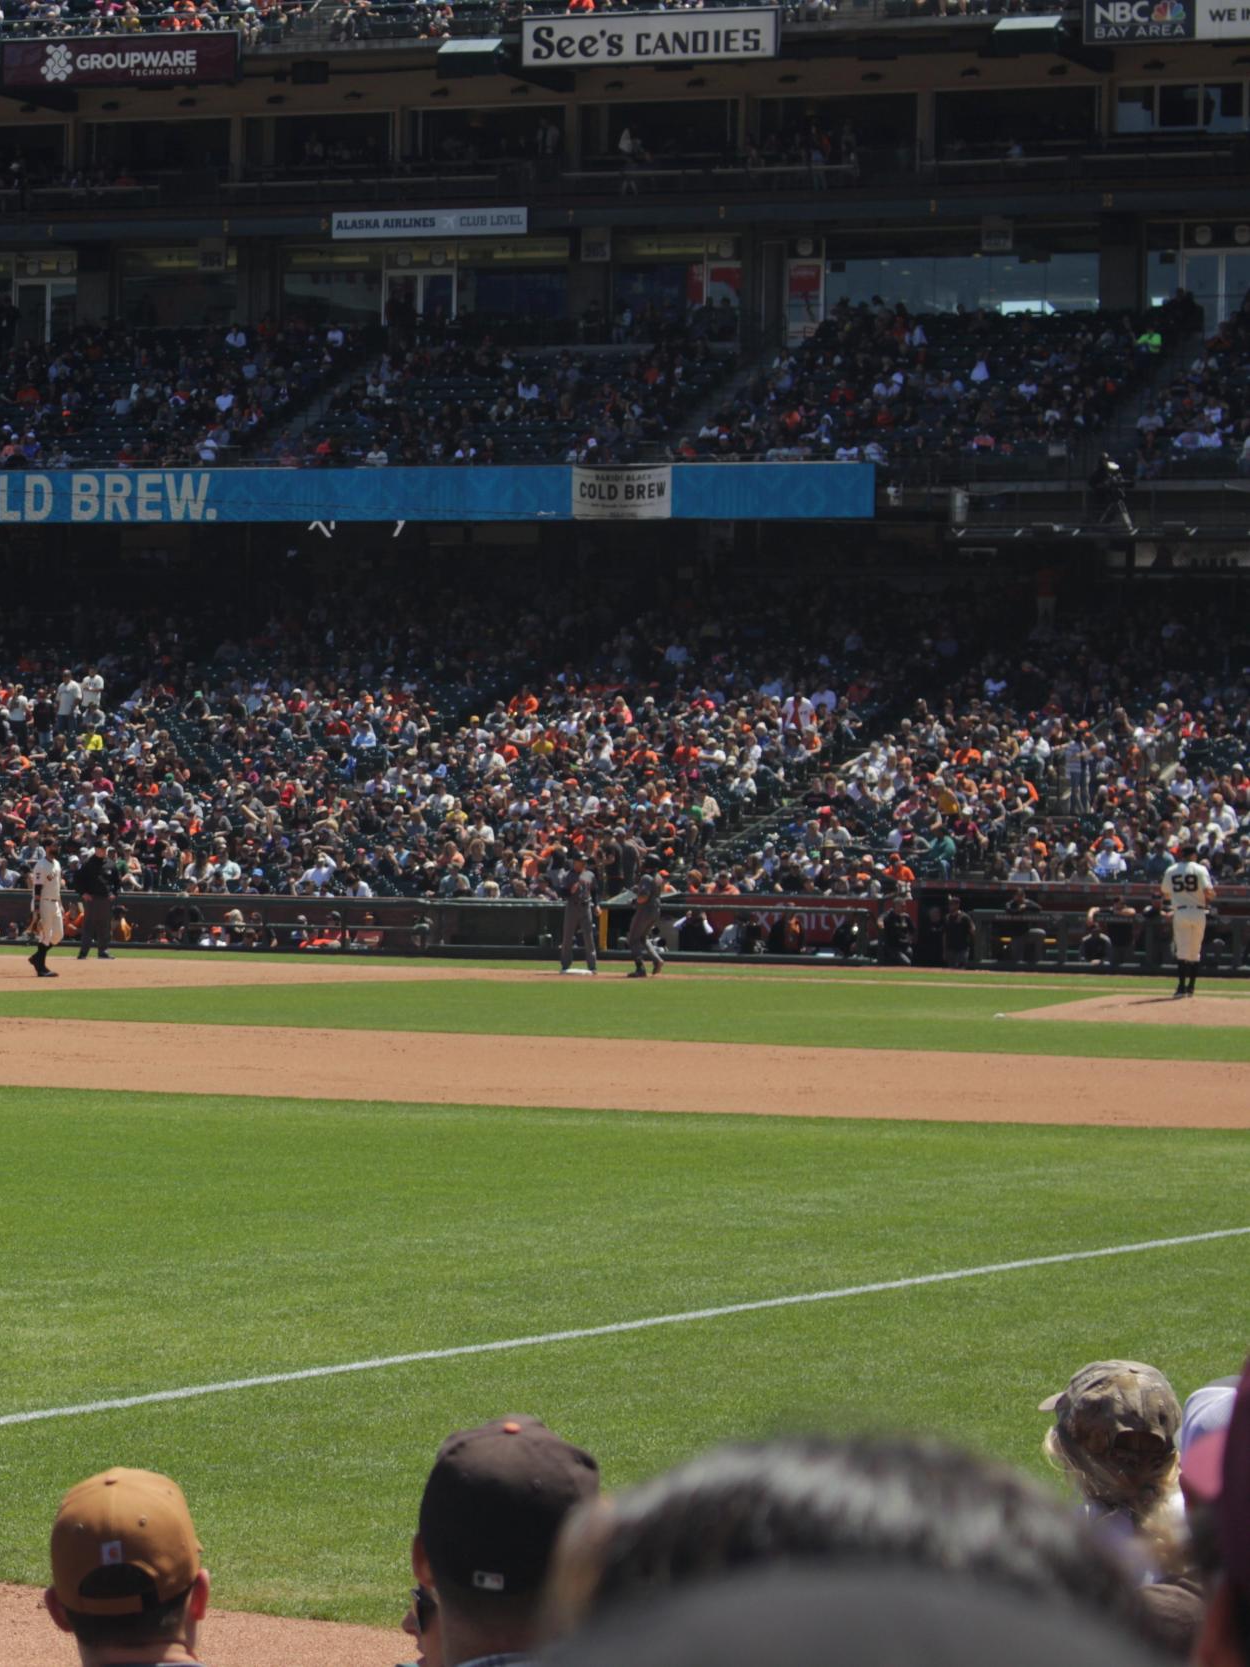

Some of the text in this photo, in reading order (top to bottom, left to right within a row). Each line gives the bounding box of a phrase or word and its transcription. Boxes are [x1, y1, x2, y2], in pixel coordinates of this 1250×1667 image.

[1094, 1, 1149, 23] NBC
[1209, 8, 1237, 22] WE
[1094, 24, 1186, 39] BAY AREA
[532, 26, 761, 59] See's CANDIES
[76, 50, 197, 70] GROUPWARE
[130, 68, 197, 77] TECHNOLOGY
[336, 218, 380, 231] ALASKA
[383, 216, 436, 229] AIRLINES
[459, 215, 488, 227] CLUB
[490, 213, 523, 226] LEVEL
[71, 473, 217, 520] BREW.
[579, 480, 666, 500] COLD BREW
[1172, 874, 1198, 892] 59
